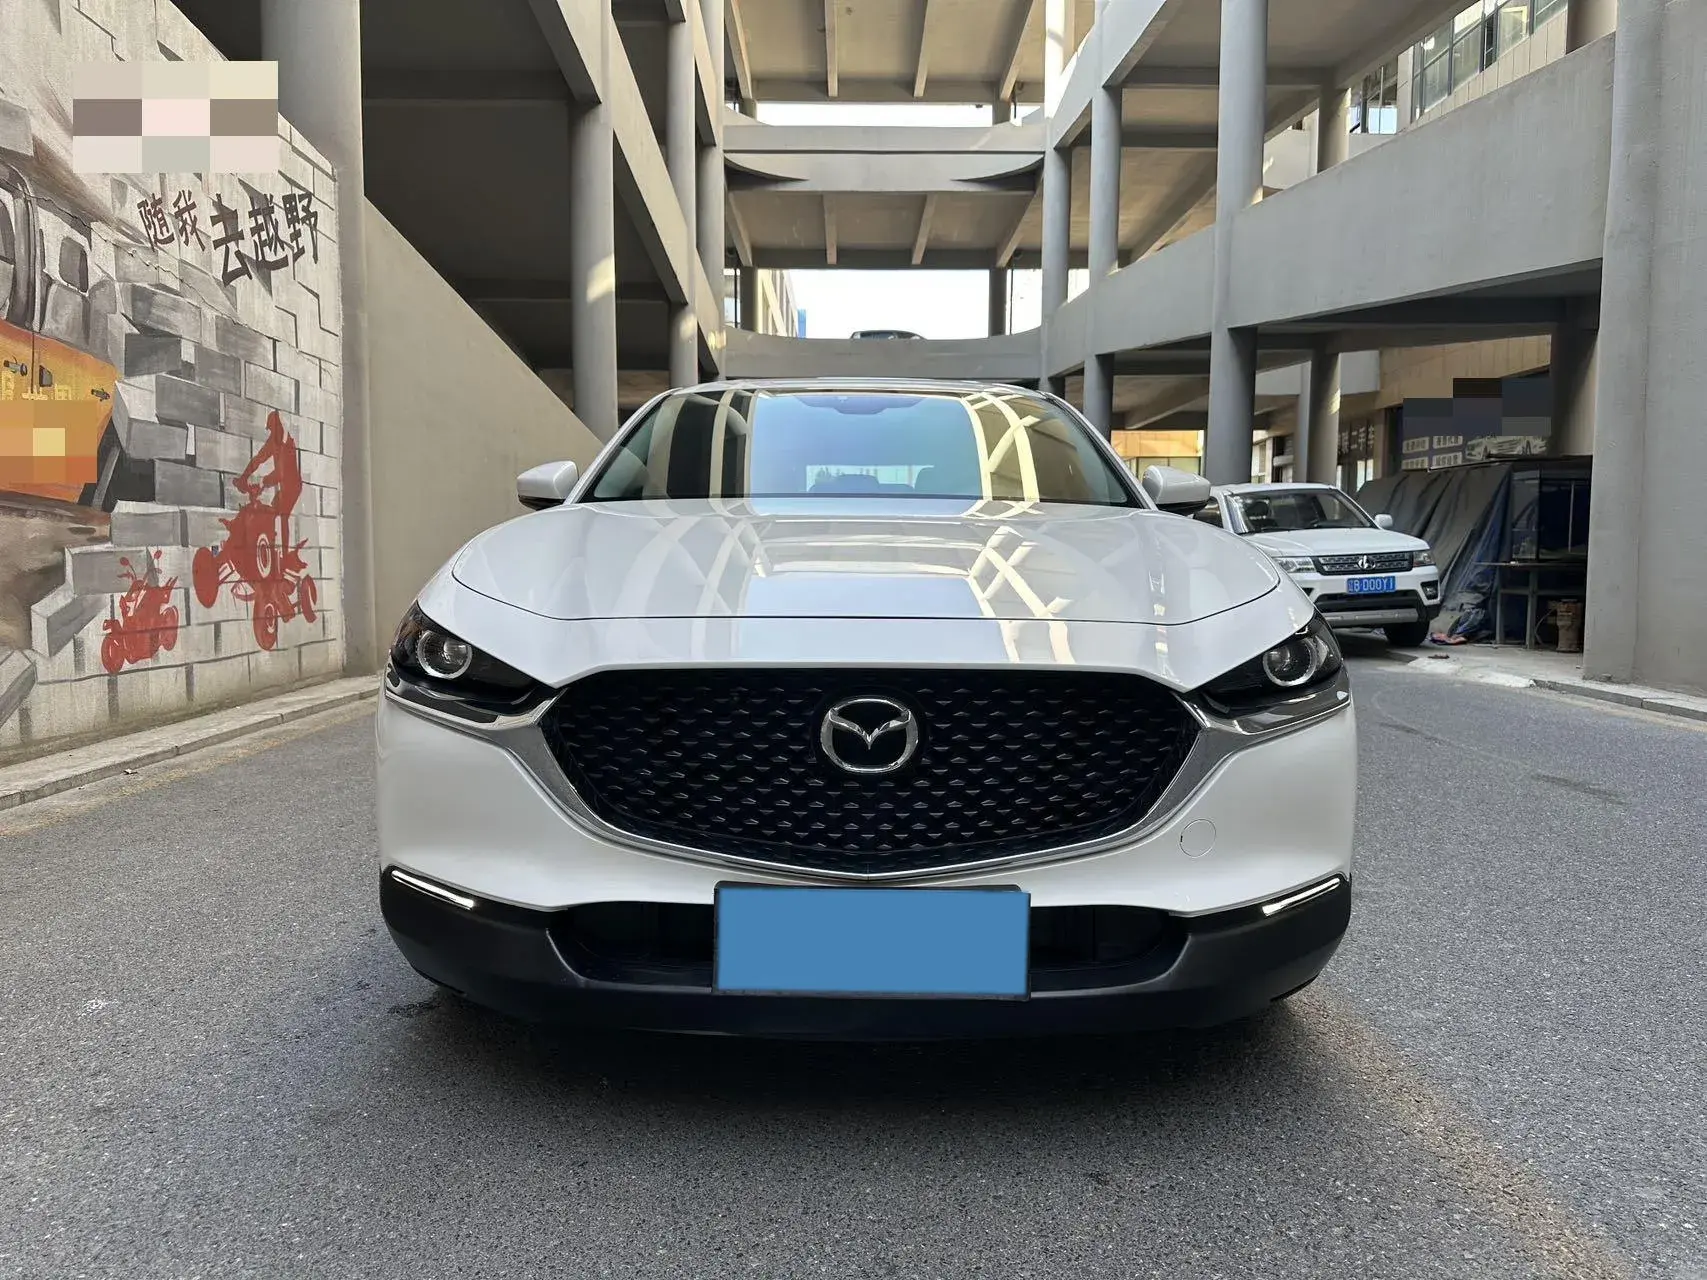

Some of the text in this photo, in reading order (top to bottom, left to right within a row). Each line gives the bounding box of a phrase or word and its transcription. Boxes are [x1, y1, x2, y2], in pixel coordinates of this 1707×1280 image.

[137, 189, 318, 287] 随我去越野
